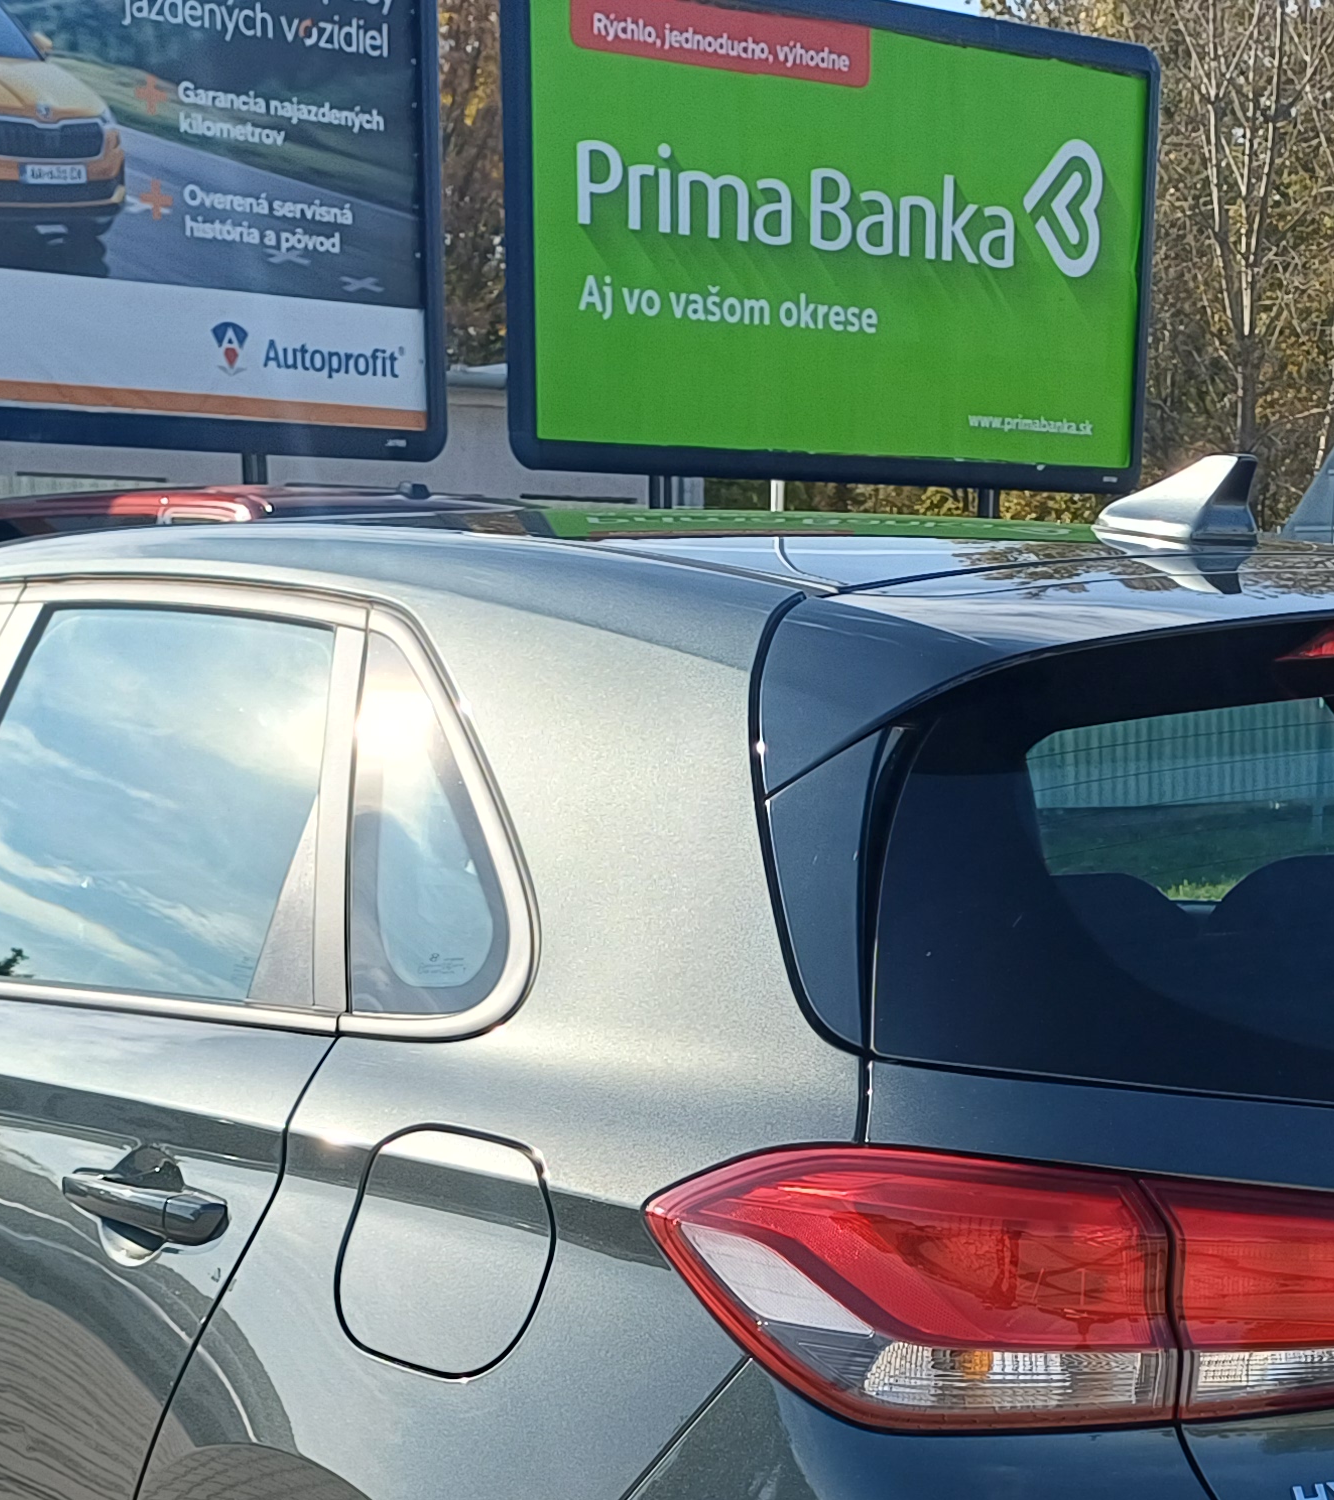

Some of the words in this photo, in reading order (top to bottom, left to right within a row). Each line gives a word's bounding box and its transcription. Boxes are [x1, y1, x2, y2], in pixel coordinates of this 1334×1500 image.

[280, 14, 389, 58] vozidiel
[593, 12, 663, 48] Rýchlo,
[664, 23, 774, 64] jednoducho,
[776, 40, 850, 72] výhodne
[177, 80, 267, 114] Garancia
[269, 96, 385, 133] najazdených
[178, 111, 286, 147] kilometrov
[183, 184, 270, 216] Overená
[272, 200, 354, 226] servisná
[576, 139, 792, 247] Prima
[810, 167, 1015, 269] Banka
[184, 215, 260, 245] história
[263, 229, 277, 246] a
[279, 228, 341, 255] pôvod
[578, 274, 613, 320] Aj
[621, 287, 661, 317] vo
[668, 285, 770, 327] vašom
[778, 292, 879, 334] okrese
